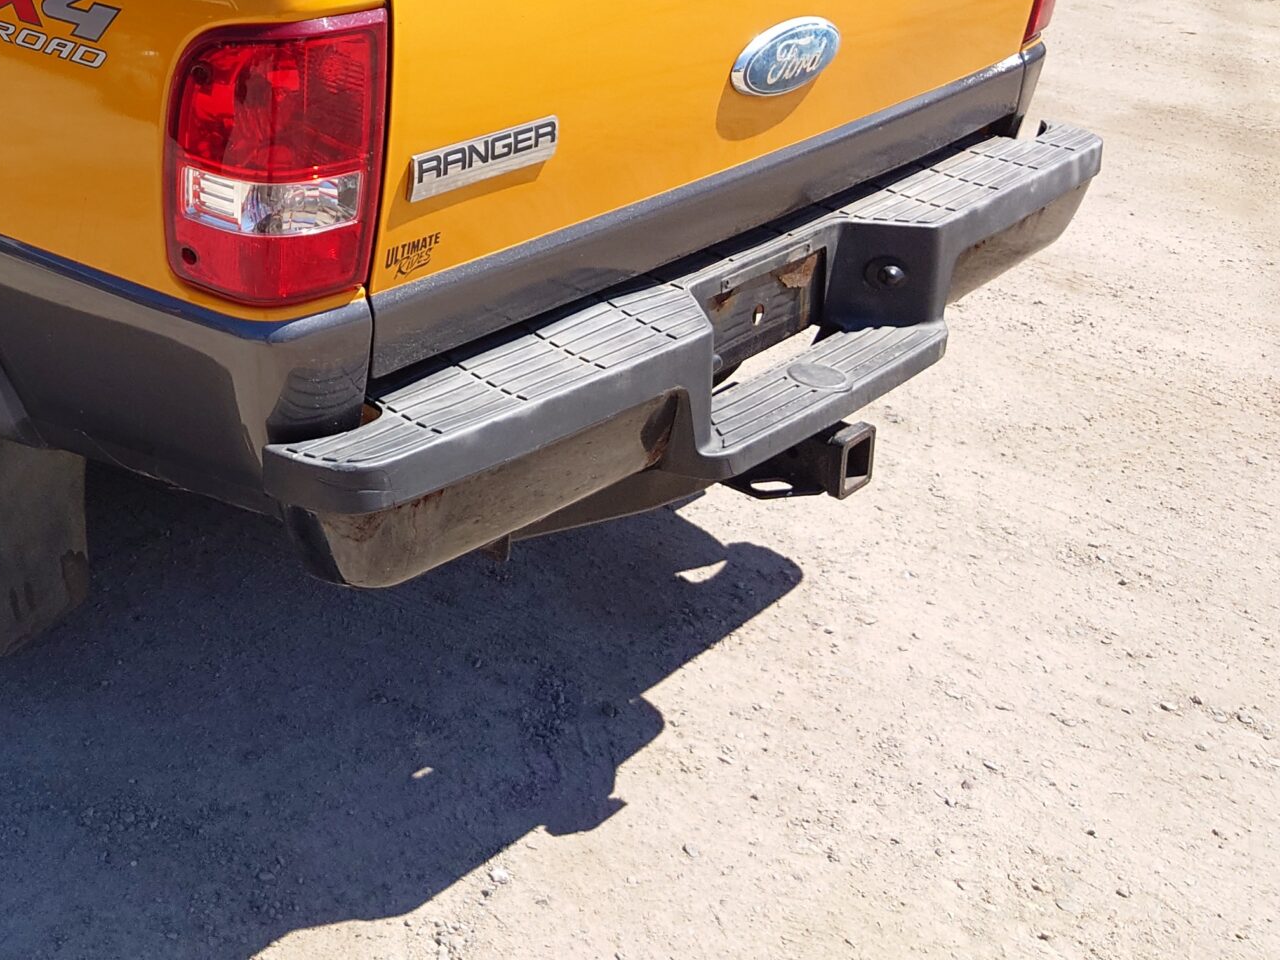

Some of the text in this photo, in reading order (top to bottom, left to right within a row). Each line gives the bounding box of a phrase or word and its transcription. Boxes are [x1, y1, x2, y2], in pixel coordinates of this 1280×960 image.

[766, 34, 827, 85] Ford
[417, 120, 556, 184] RANGER
[385, 231, 441, 269] ULTIMATE
